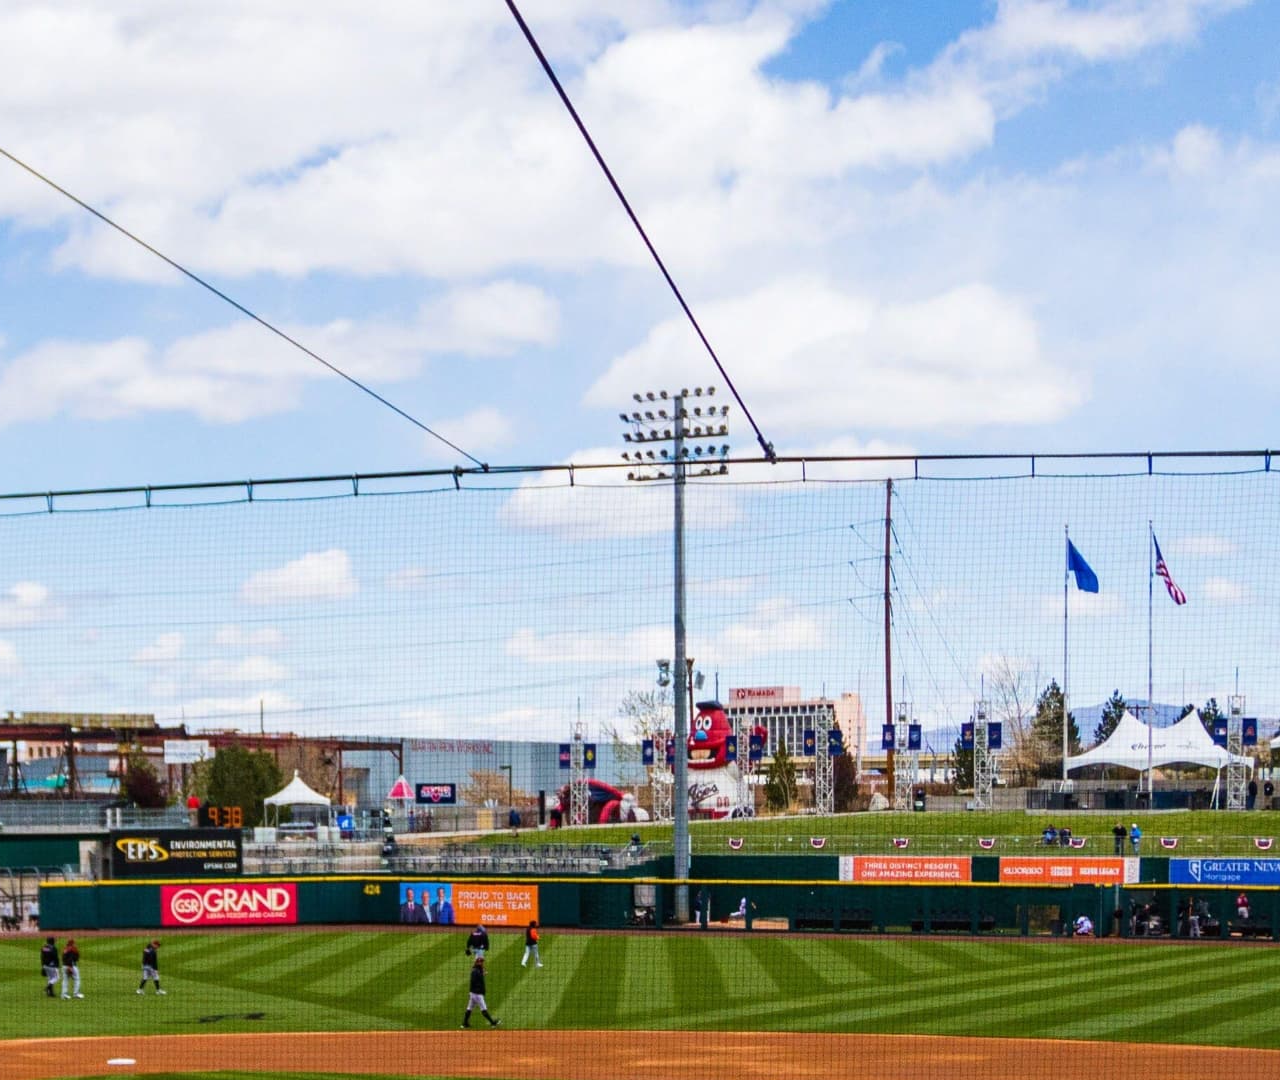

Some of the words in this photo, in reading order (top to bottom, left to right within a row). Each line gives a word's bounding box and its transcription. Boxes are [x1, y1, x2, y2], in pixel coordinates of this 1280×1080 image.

[127, 840, 160, 859] EPS
[170, 840, 237, 849] ENVIRONMENTAL
[1203, 861, 1250, 872] GREATER
[862, 870, 877, 878] ONE
[880, 870, 912, 878] AMAZING
[204, 888, 290, 911] GRAND
[458, 891, 488, 900] PROUD
[492, 892, 503, 900] TO
[506, 892, 531, 900] BACK
[175, 900, 199, 913] GSR
[458, 901, 475, 909] THE
[507, 902, 531, 910] TEAM
